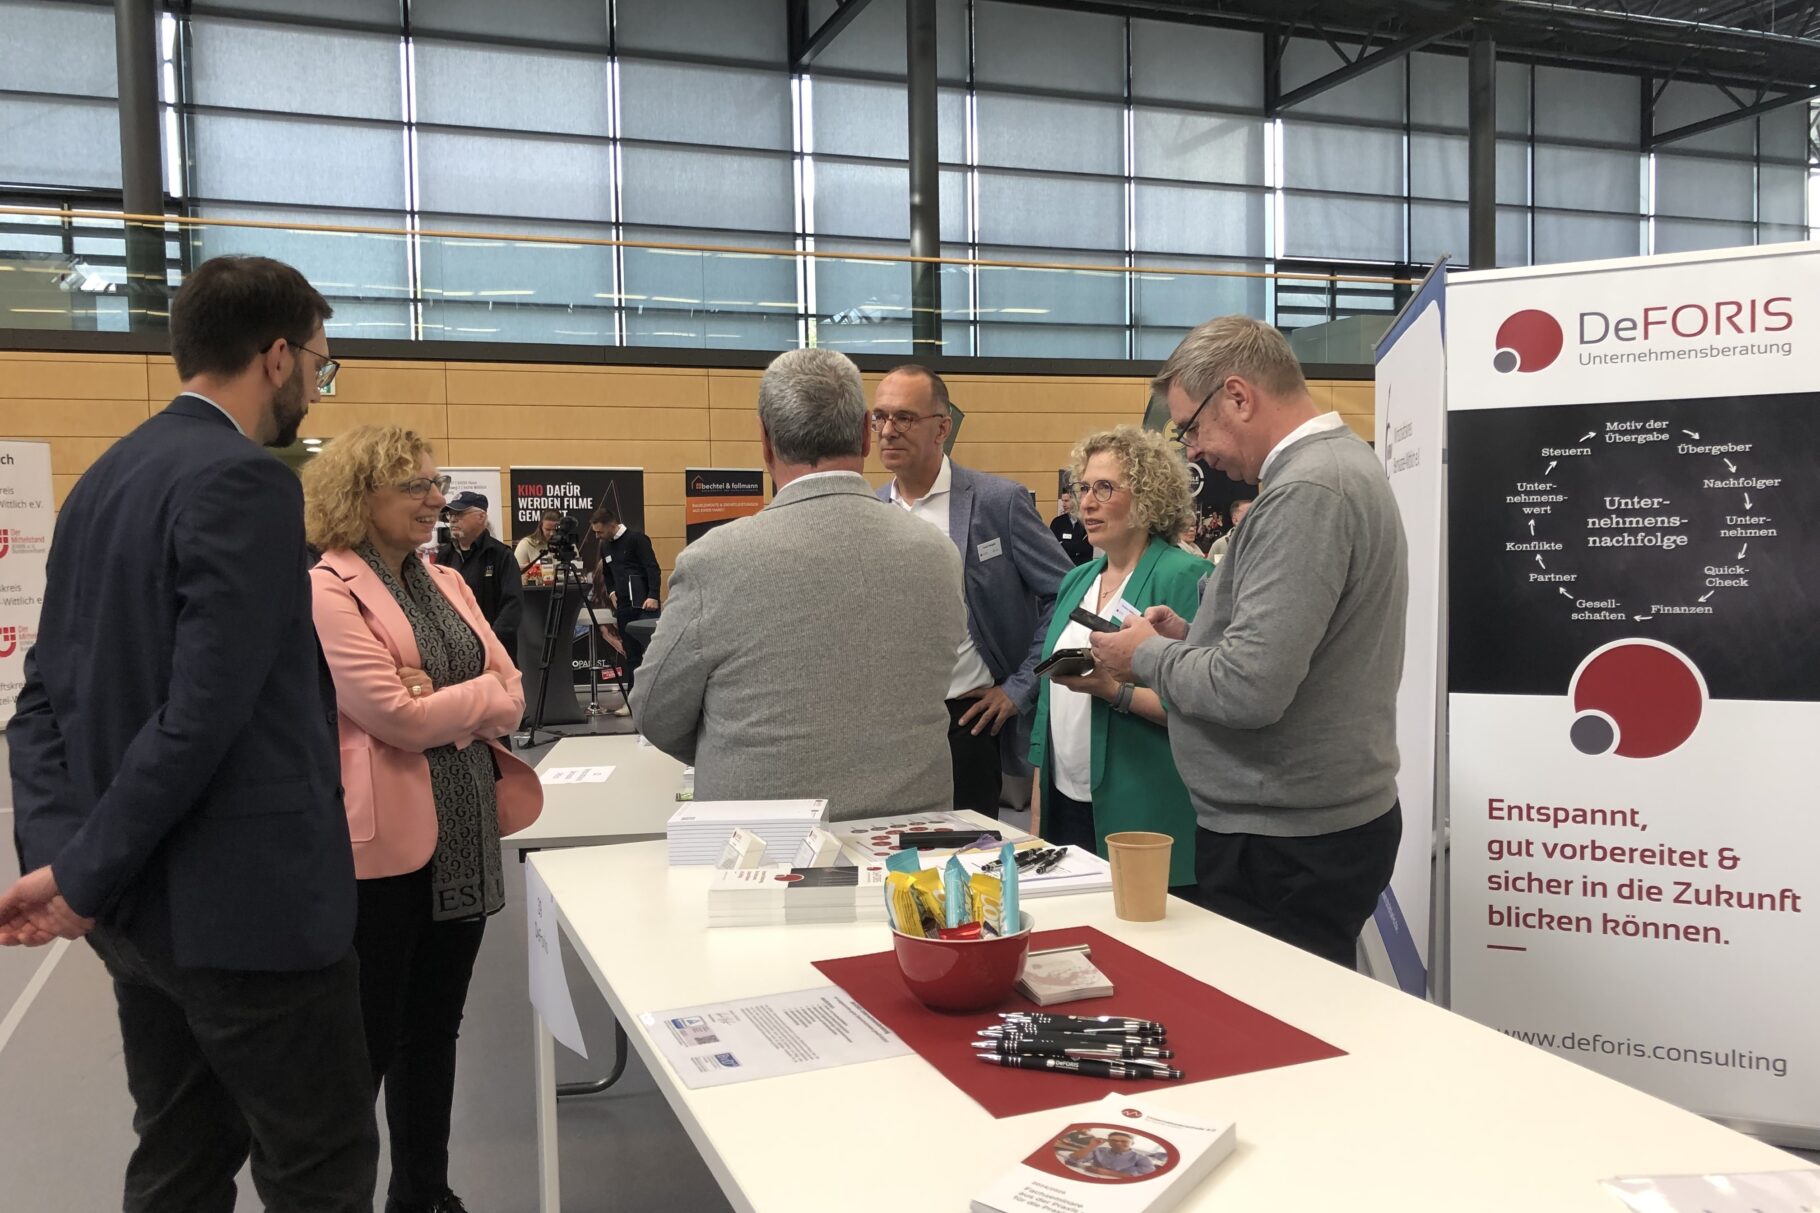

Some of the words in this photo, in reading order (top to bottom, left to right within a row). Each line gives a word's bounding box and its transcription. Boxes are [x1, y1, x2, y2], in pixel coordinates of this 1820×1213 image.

[1579, 296, 1793, 345] DeFORIS
[1580, 343, 1791, 365] Unternehmensberatung
[1606, 421, 1643, 430] Motiv
[1646, 420, 1669, 428] der
[1605, 432, 1669, 444] Übergabe
[1542, 448, 1591, 456] Steuern
[1678, 443, 1752, 455] Übergeber
[518, 485, 544, 496] KINO
[546, 482, 580, 496] DAFÜR
[1517, 482, 1556, 491] Unter-
[1704, 478, 1781, 489] Nachfolger
[518, 498, 560, 509] WERDEN
[564, 498, 593, 509] FILME
[1506, 494, 1568, 502] nehmens-
[1604, 496, 1670, 509] Unter-
[519, 510, 568, 522] GEMT
[1587, 515, 1688, 528] nehmens-
[1726, 516, 1771, 524] Unter-
[1720, 528, 1777, 536] nehmen
[1506, 542, 1562, 550] Konflikte
[1588, 533, 1688, 549] nachfolge
[1704, 565, 1749, 575] Quick-
[1529, 573, 1576, 581] Partner
[1706, 578, 1748, 586] Check
[1577, 599, 1620, 608] Gesell-
[1651, 605, 1712, 613] Finanzen
[1572, 611, 1625, 620] schaften
[1489, 799, 1647, 831] Entspannt,
[1488, 839, 1533, 860] gut
[1542, 840, 1708, 868] vorbereitet
[1718, 848, 1740, 870] &
[1488, 870, 1573, 895] sicher
[1583, 875, 1607, 898] in
[1617, 878, 1662, 902] die
[1673, 882, 1801, 912] Zukunft
[1489, 905, 1591, 933] blicken
[1603, 913, 1729, 944] können.
